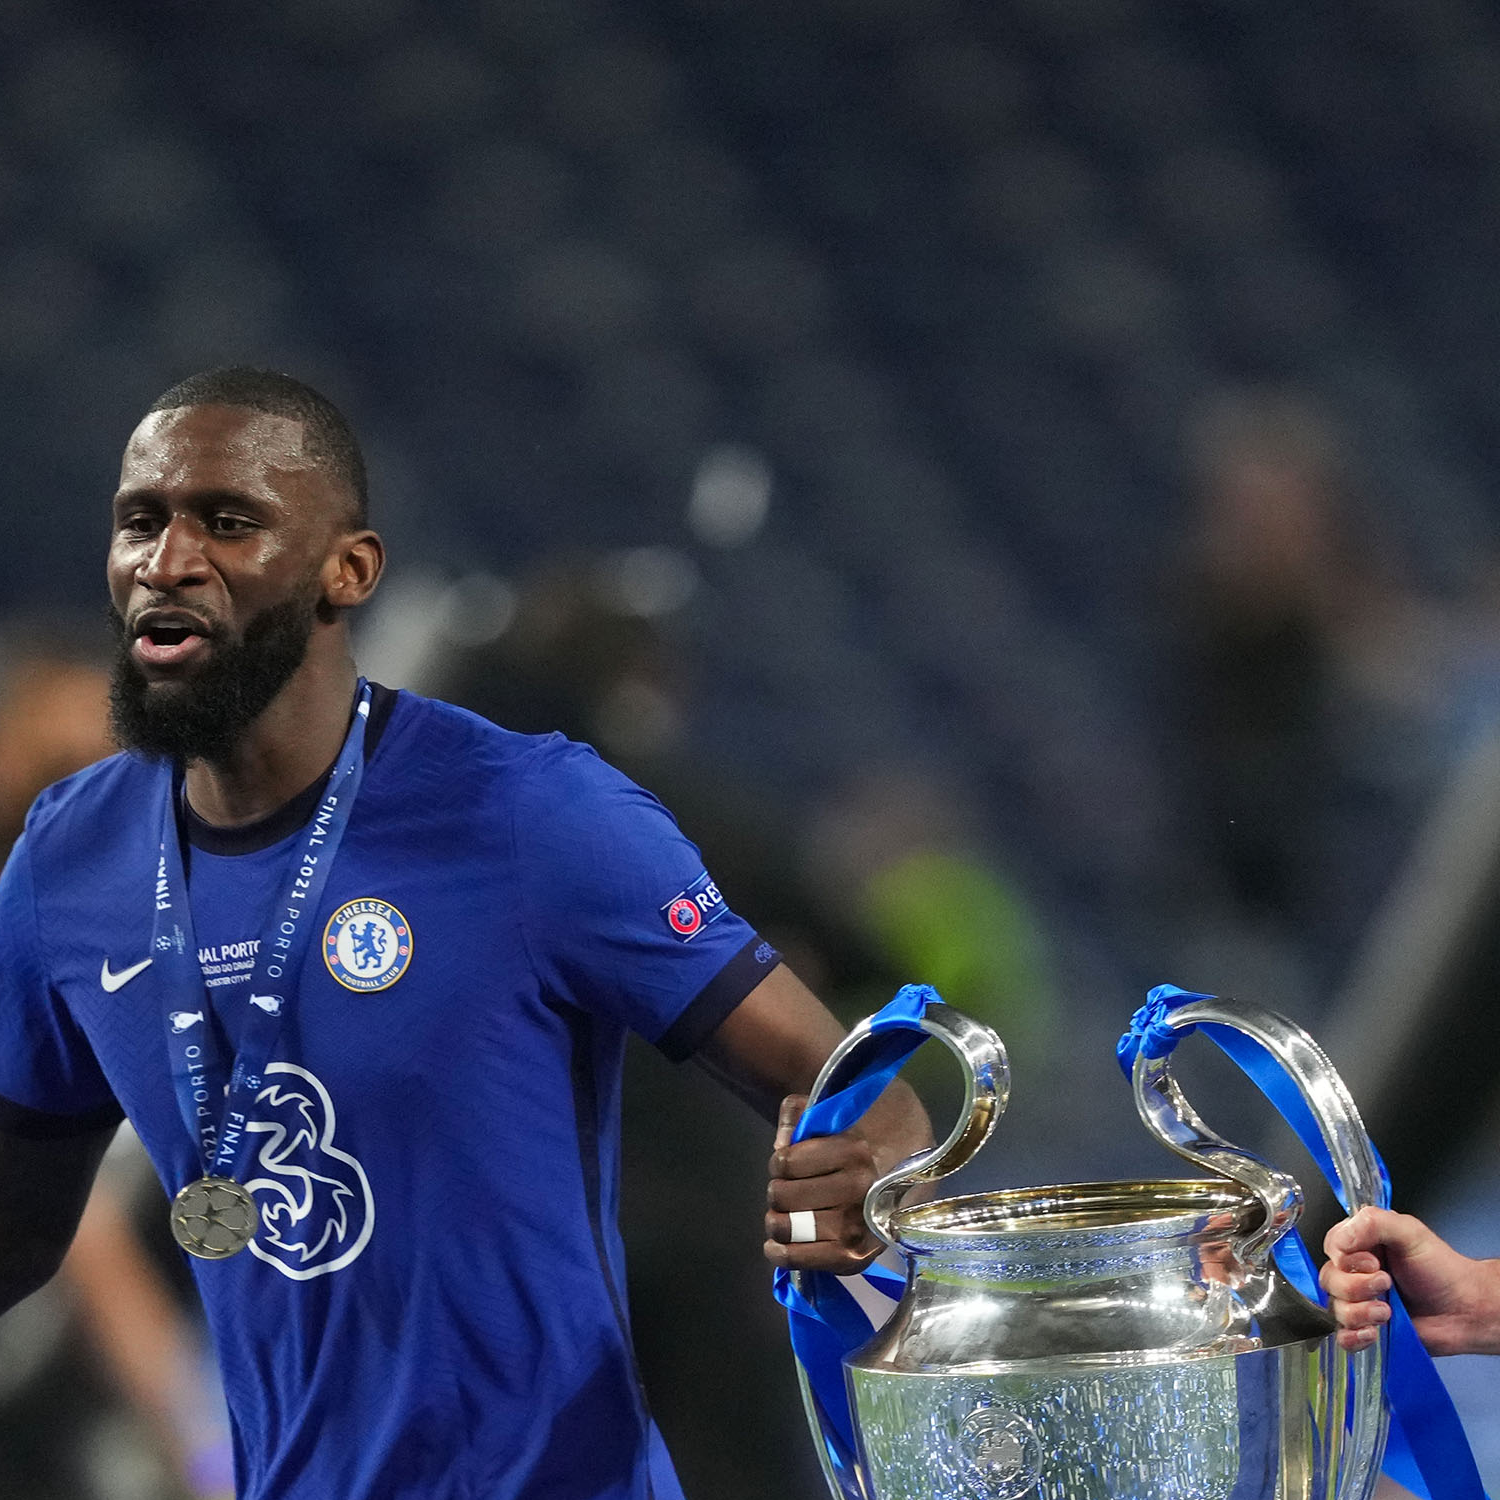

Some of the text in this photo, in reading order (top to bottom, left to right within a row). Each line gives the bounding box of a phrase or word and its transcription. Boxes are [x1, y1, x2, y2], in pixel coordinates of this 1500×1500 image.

[266, 796, 338, 978] FINAL 2021 PORTO
[335, 902, 393, 925] CHELSEA
[198, 946, 221, 964] NAL
[341, 966, 400, 988] FOOTBALL CLUB
[185, 1045, 217, 1160] 021 PORTO
[216, 1112, 245, 1166] FINAL
